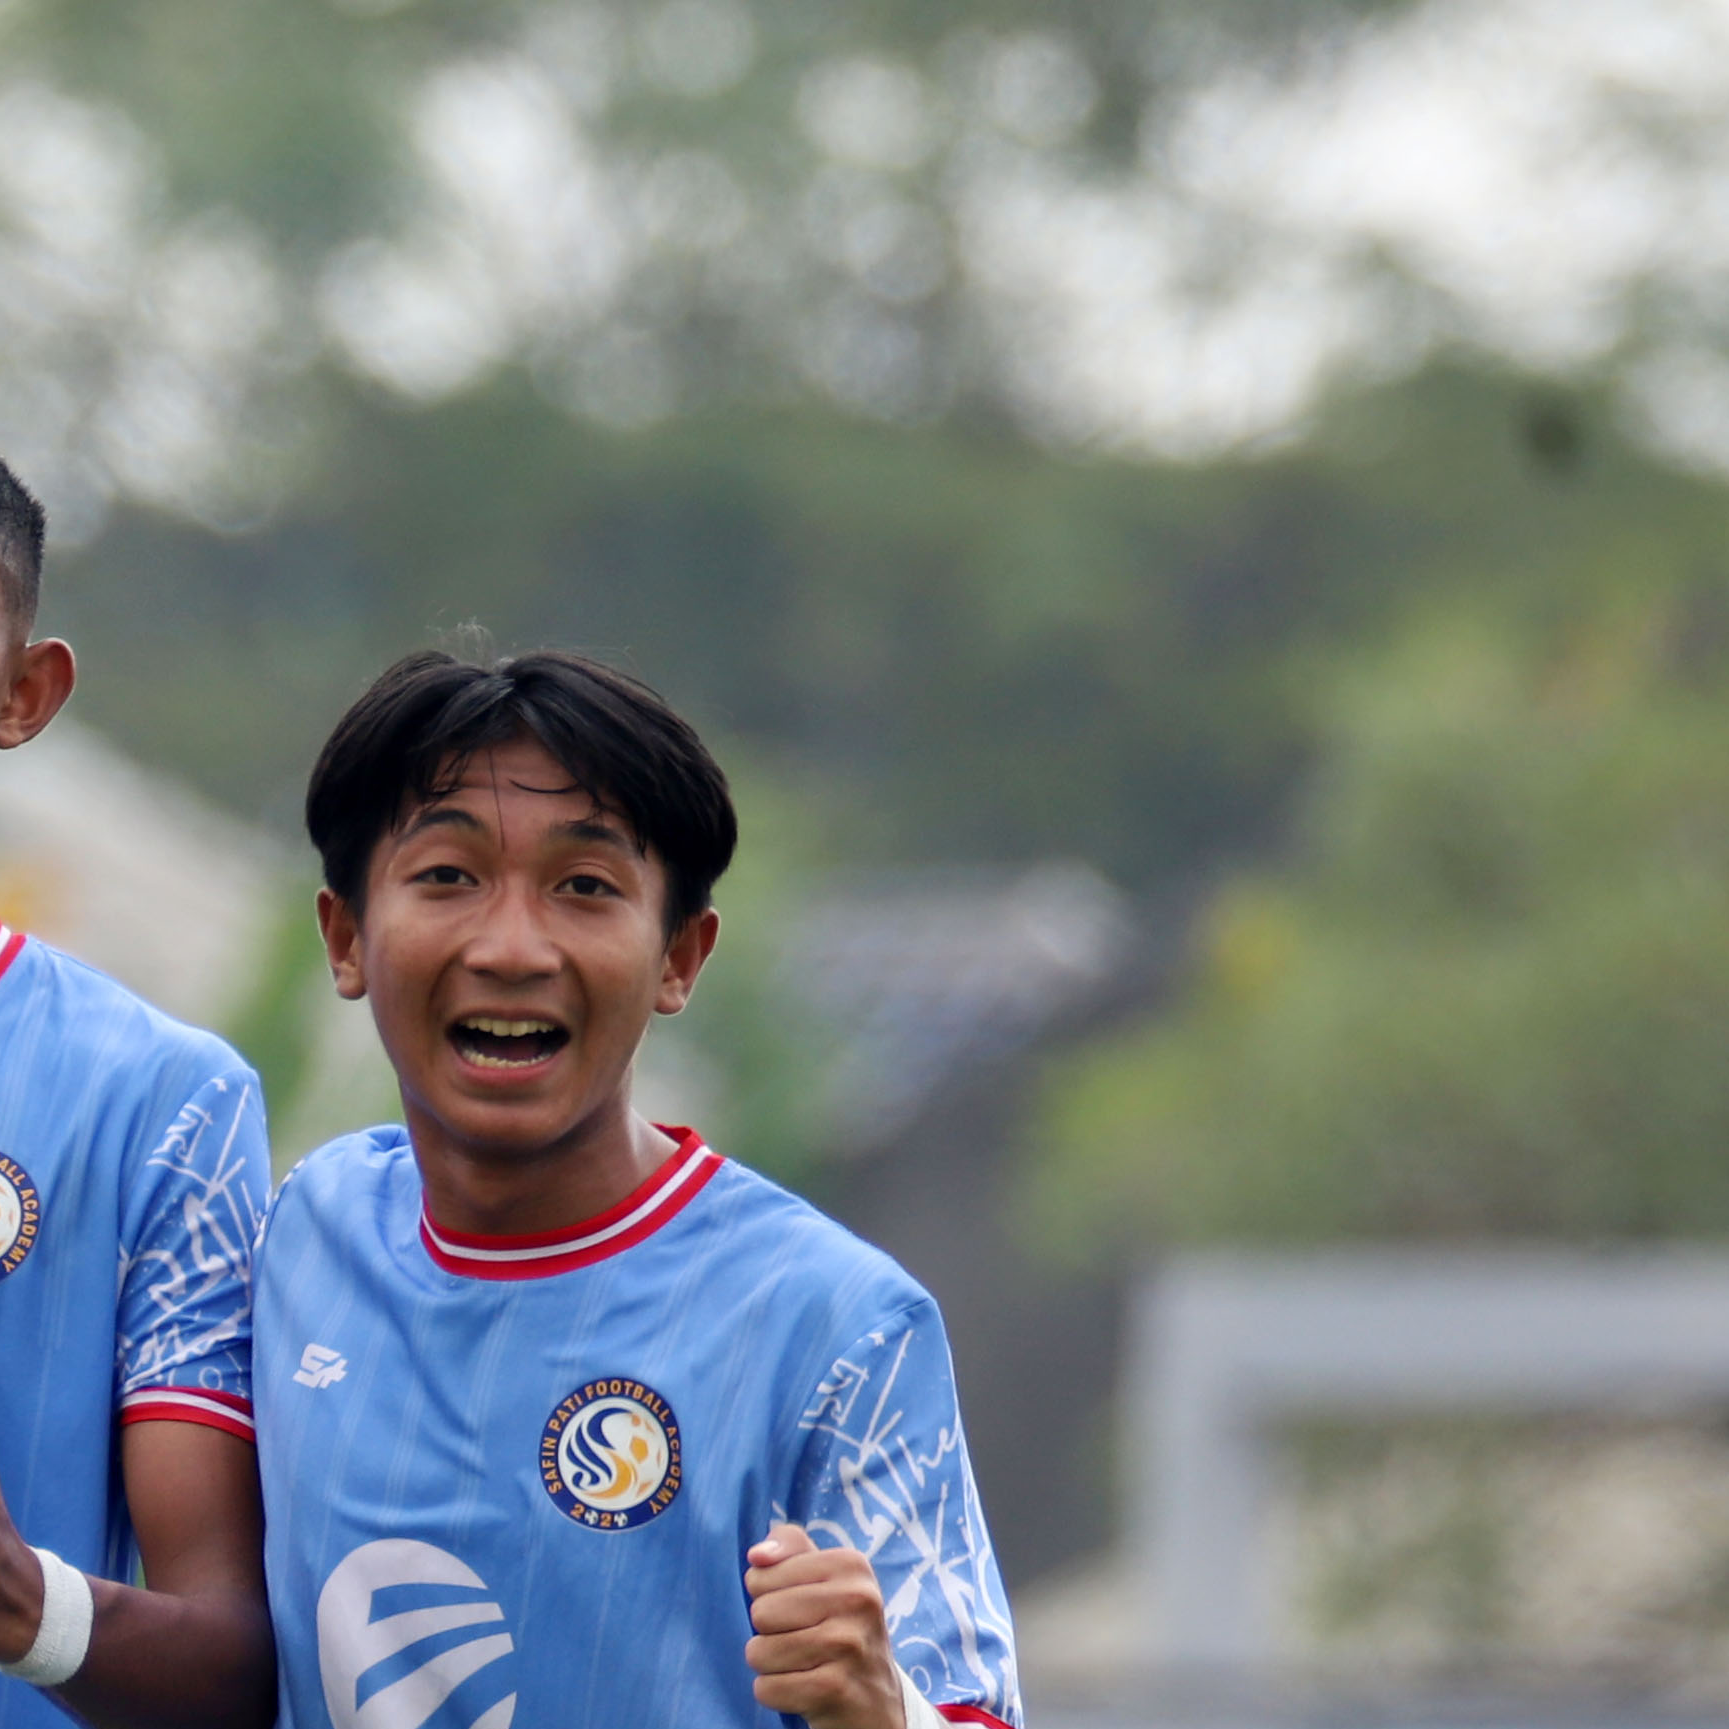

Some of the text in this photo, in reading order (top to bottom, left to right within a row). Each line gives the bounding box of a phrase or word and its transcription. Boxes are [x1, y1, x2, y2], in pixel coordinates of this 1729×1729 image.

[1, 1188, 39, 1273] ACADEMY
[541, 1379, 682, 1515] SAFIN PATI FOOTBALL ACADEMY
